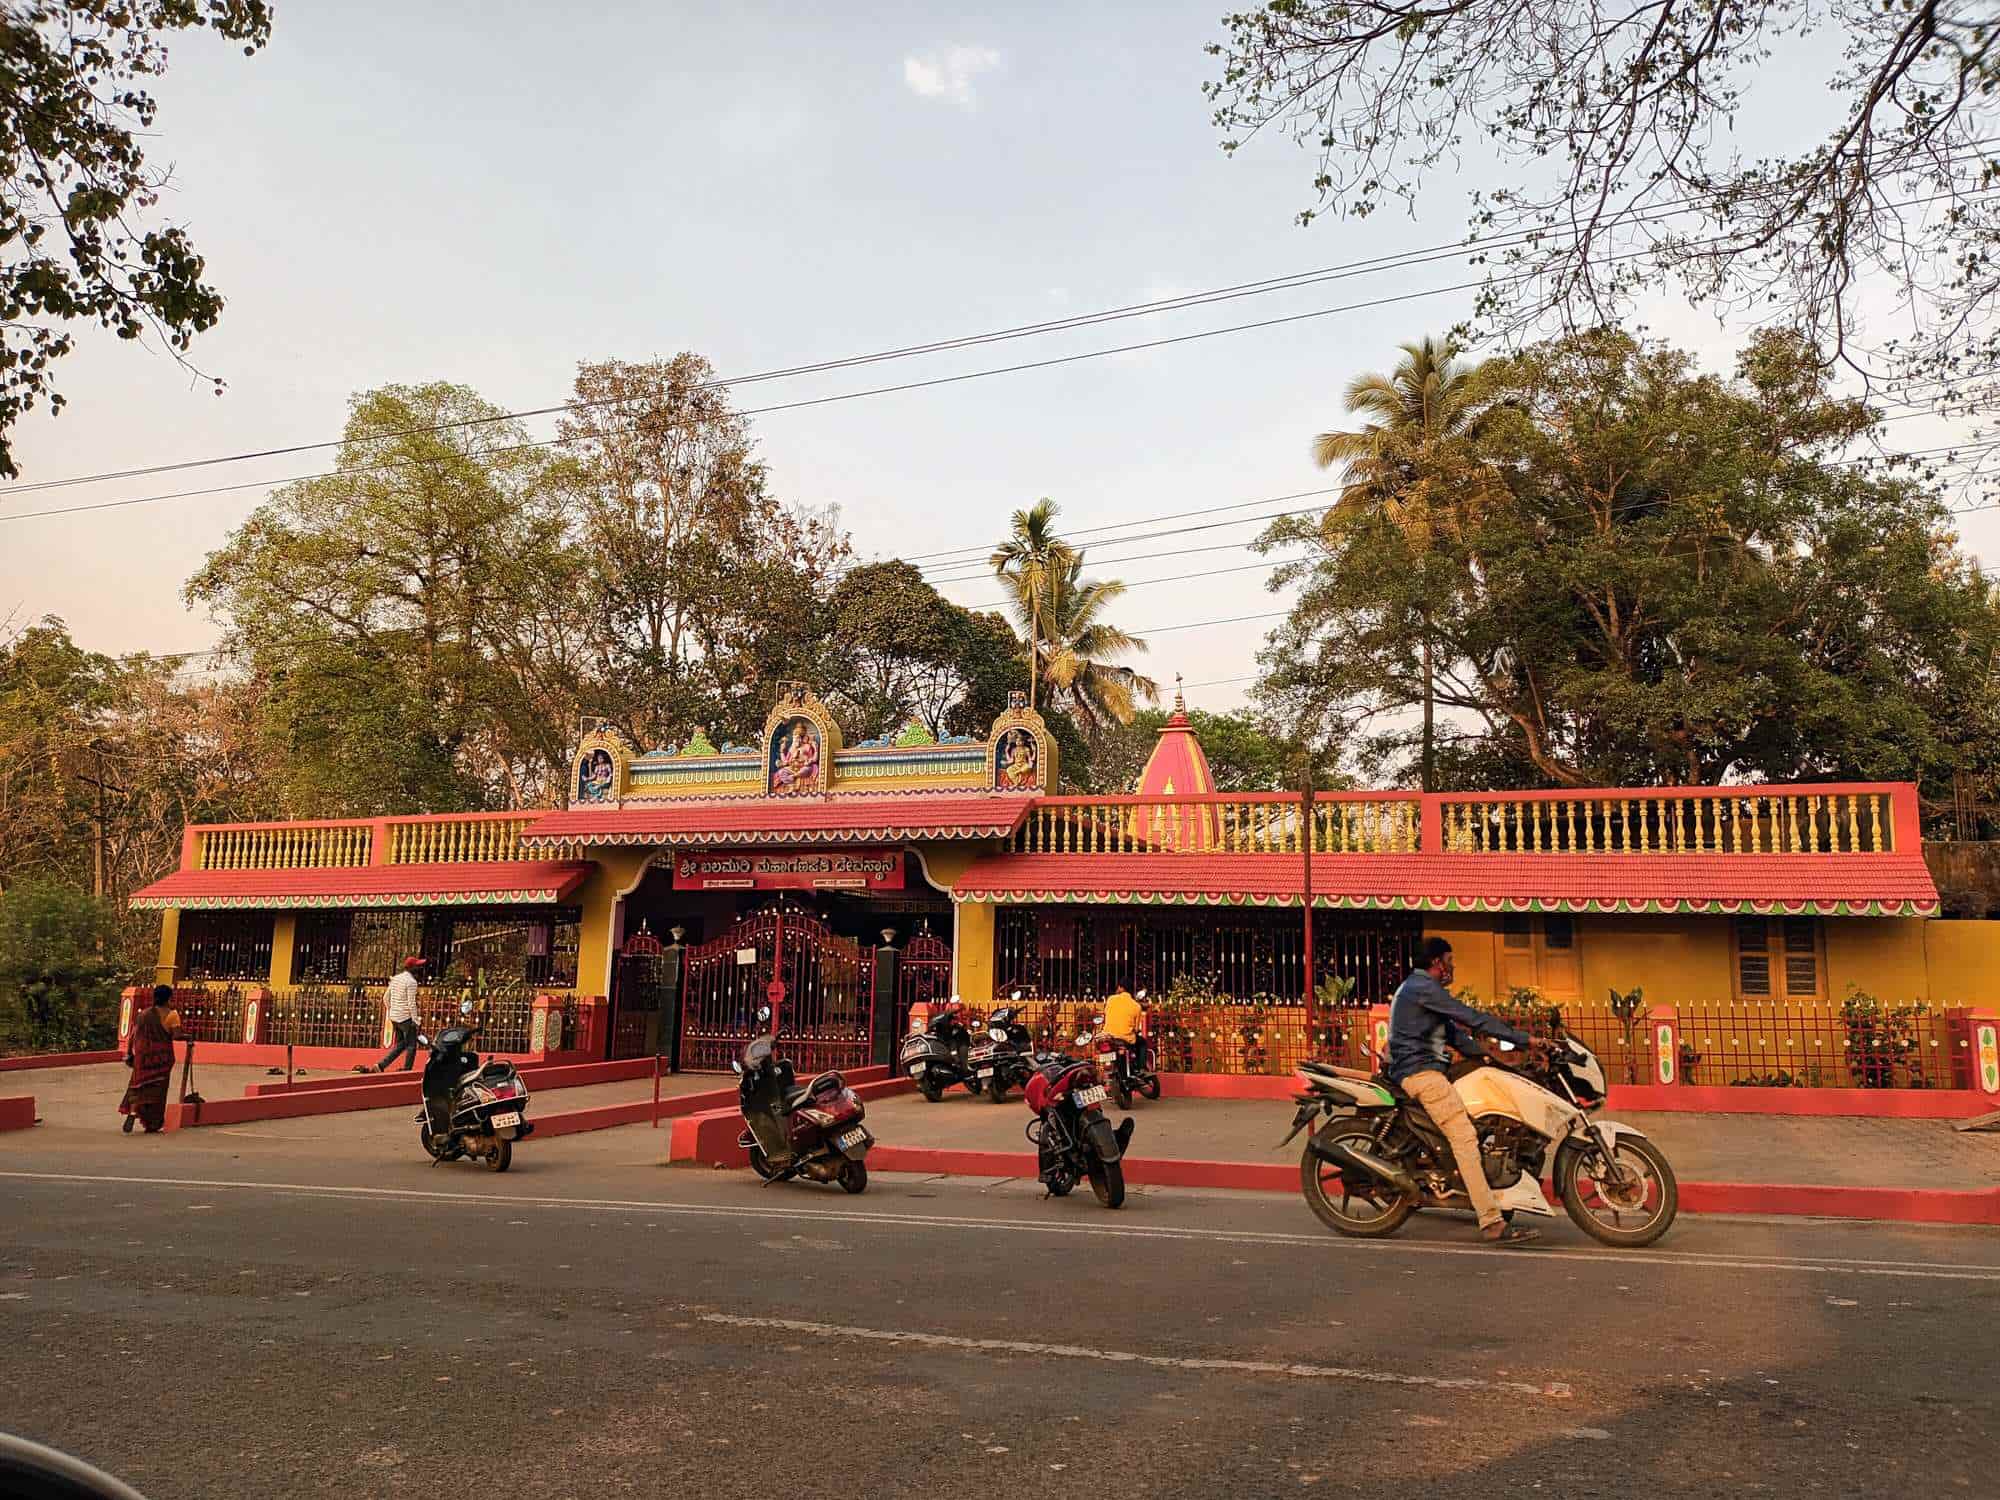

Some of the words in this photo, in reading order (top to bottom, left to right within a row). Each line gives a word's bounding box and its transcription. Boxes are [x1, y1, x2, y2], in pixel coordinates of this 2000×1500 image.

[680, 859, 697, 878] ಶ್ರೀ
[701, 859, 752, 873] ಬಲಮುರಿ
[756, 859, 830, 873] ಮಹಾಗಣಪತಿ
